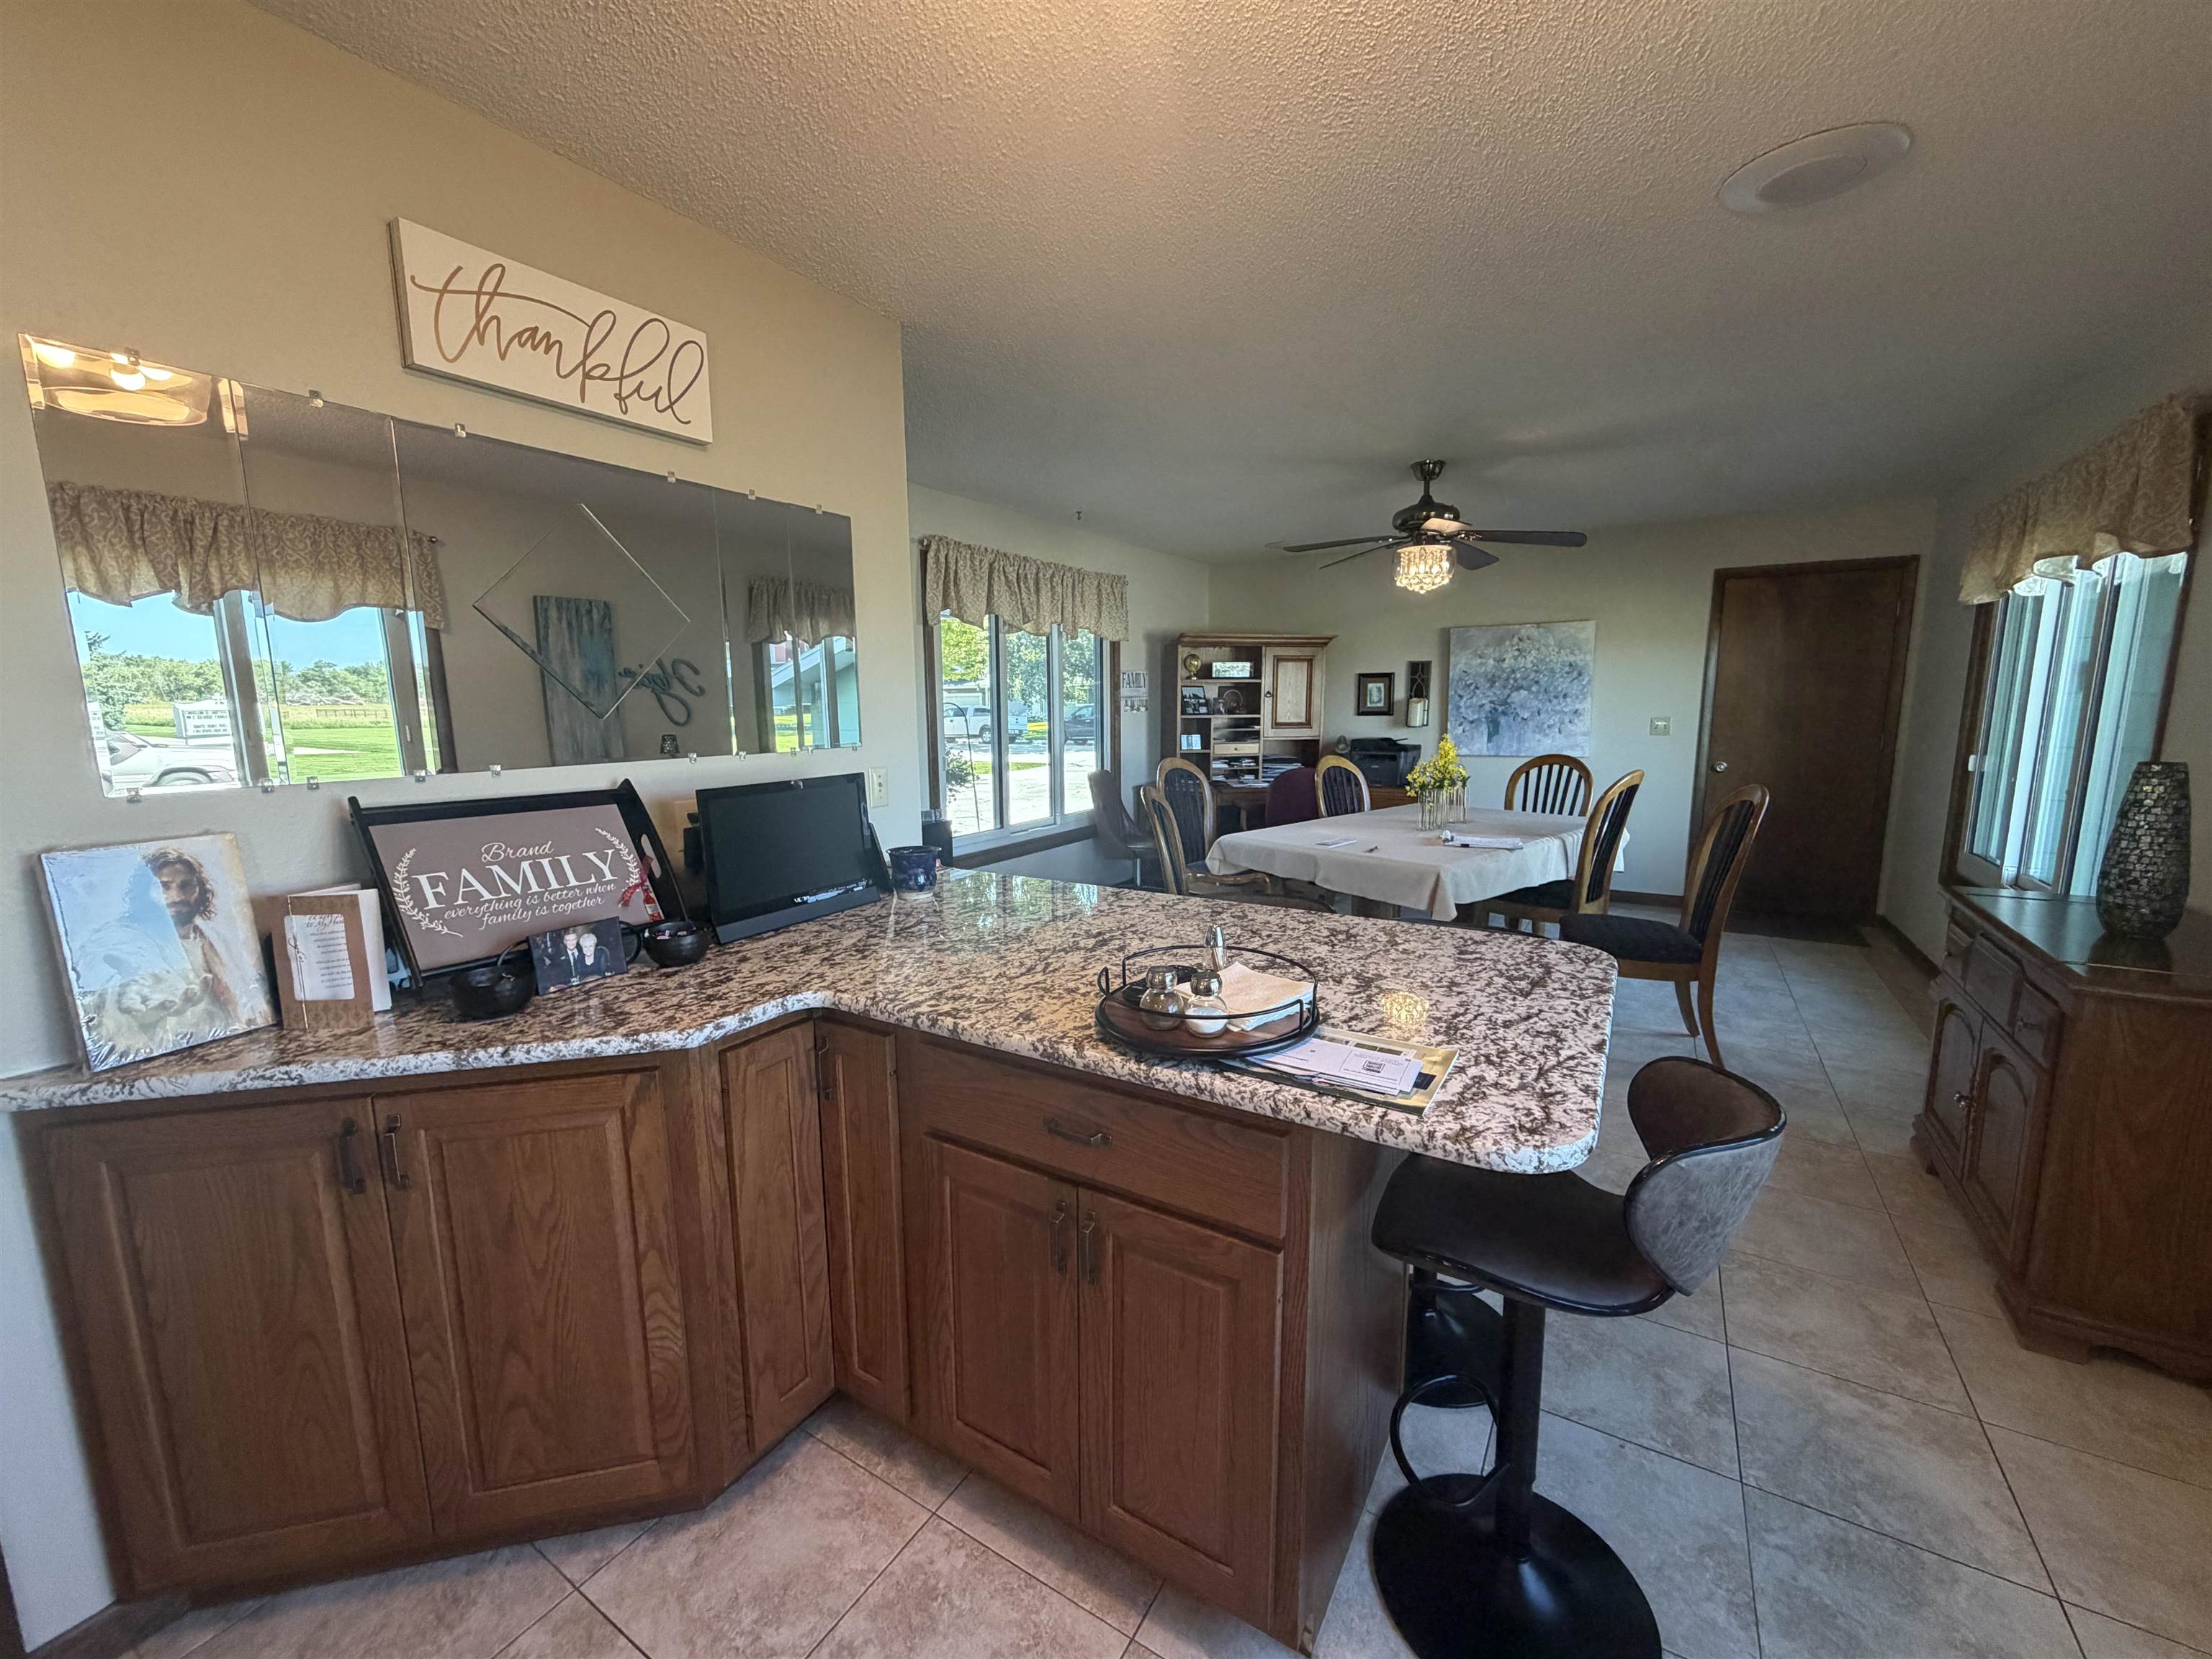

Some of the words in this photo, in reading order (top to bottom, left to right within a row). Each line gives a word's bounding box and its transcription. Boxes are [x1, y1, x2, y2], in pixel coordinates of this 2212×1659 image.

[410, 263, 704, 425] thankful
[1122, 672, 1148, 688] FAMILY
[481, 840, 554, 863] Brand
[411, 849, 618, 910] FAMILY
[444, 899, 523, 919] everything
[526, 894, 540, 906] is
[544, 888, 583, 901] better
[586, 882, 616, 895] when
[478, 907, 532, 930] family
[535, 906, 549, 917] is
[552, 896, 605, 914] together
